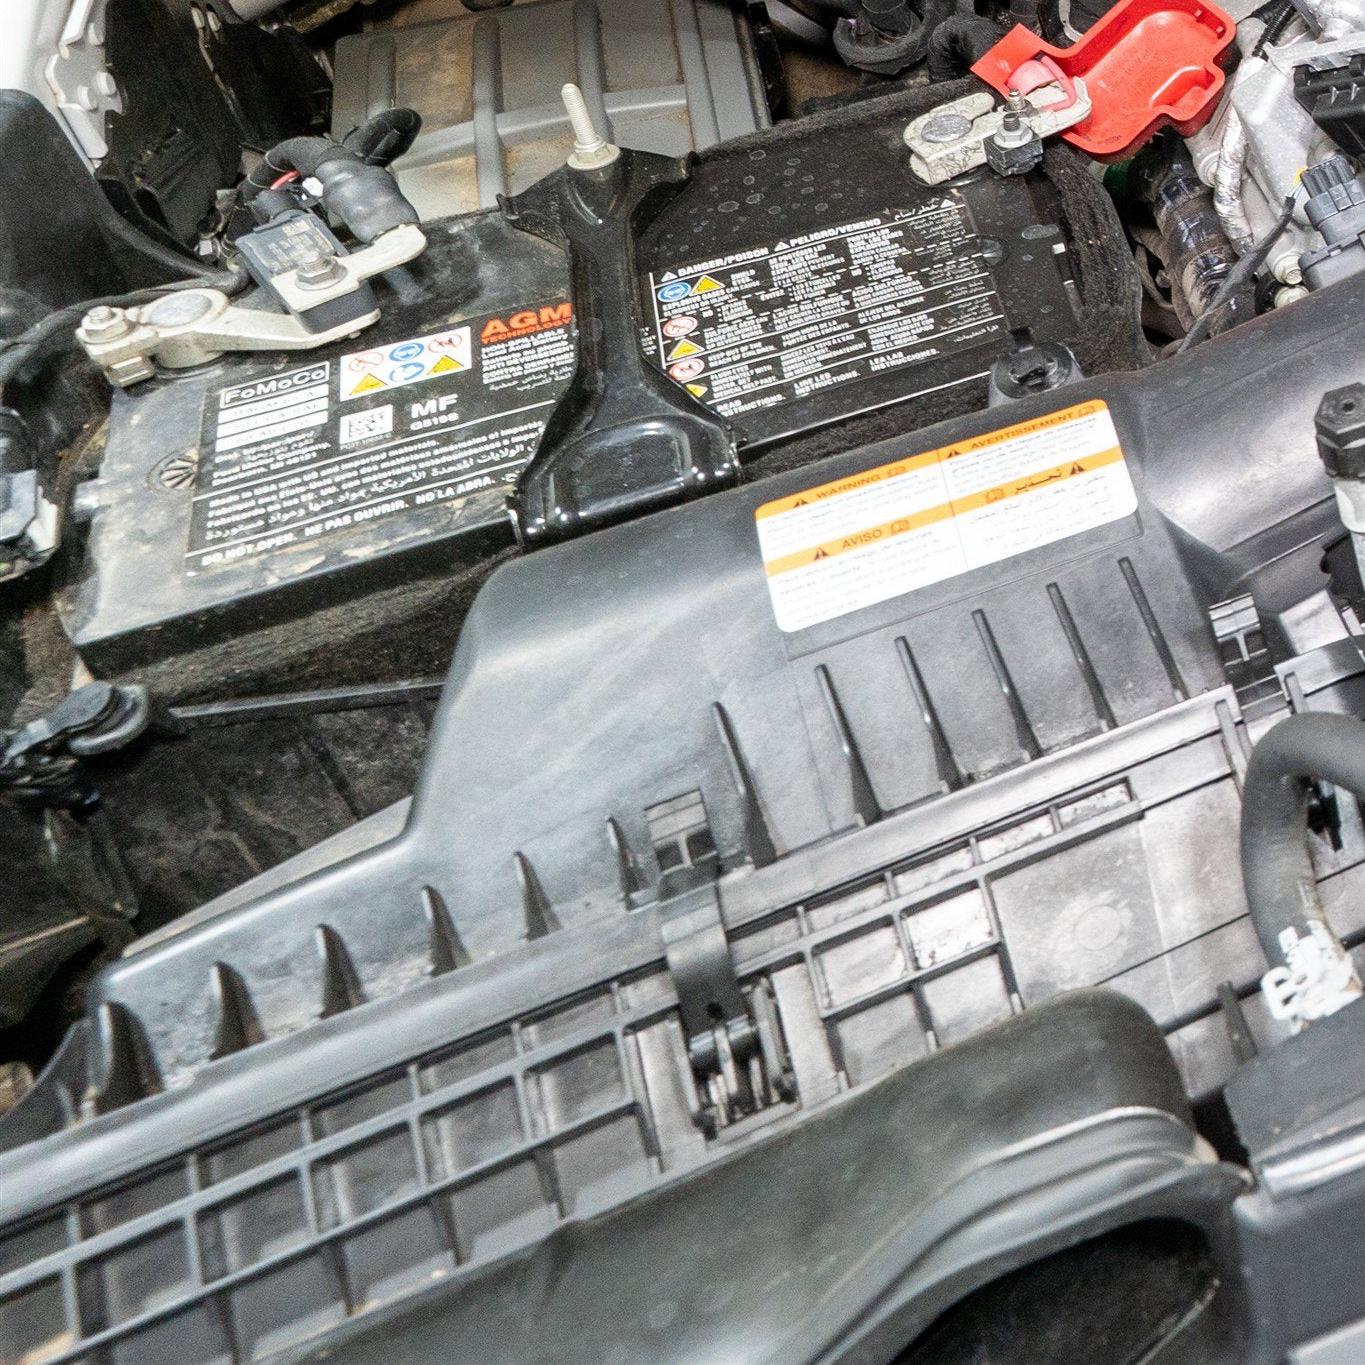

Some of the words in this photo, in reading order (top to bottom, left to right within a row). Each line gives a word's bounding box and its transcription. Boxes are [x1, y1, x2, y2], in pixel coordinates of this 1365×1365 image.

[790, 218, 880, 245] PELIGRO/VENENO
[678, 248, 768, 275] DANGER/POISON
[730, 269, 755, 279] SHIELD
[662, 296, 700, 310] EXPLOSIVE
[702, 289, 724, 299] GASES
[481, 304, 570, 337] AGM
[481, 314, 571, 343] TECHNOLOGY
[869, 356, 886, 365] LEA
[886, 351, 903, 360] LAS
[871, 349, 938, 370] INSTRUCCIONES.
[225, 370, 325, 402] FoMoCo
[793, 377, 813, 389] LIRE
[795, 370, 859, 394] INSTRUCTIONS.
[411, 394, 457, 417] MF
[716, 400, 741, 411] READ
[241, 457, 274, 469] Motor
[815, 473, 880, 499] WARNING
[971, 413, 1074, 450] AVERTISSEMENT
[209, 495, 239, 507] Made
[253, 484, 277, 495] USA
[278, 477, 301, 488] with
[302, 471, 318, 481] US
[320, 465, 339, 476] and
[340, 452, 386, 469] imported
[388, 440, 439, 456] materials.
[333, 470, 358, 481] avec
[359, 464, 378, 474] des
[415, 491, 434, 503] NO
[456, 476, 494, 493] ABRA.
[304, 523, 322, 536] NE
[324, 515, 351, 529] PAS
[353, 500, 408, 520] OUVRIR.
[201, 552, 223, 565] DO
[224, 544, 254, 559] NOT
[256, 532, 296, 551] OPEN.
[841, 528, 883, 549] AVISO
